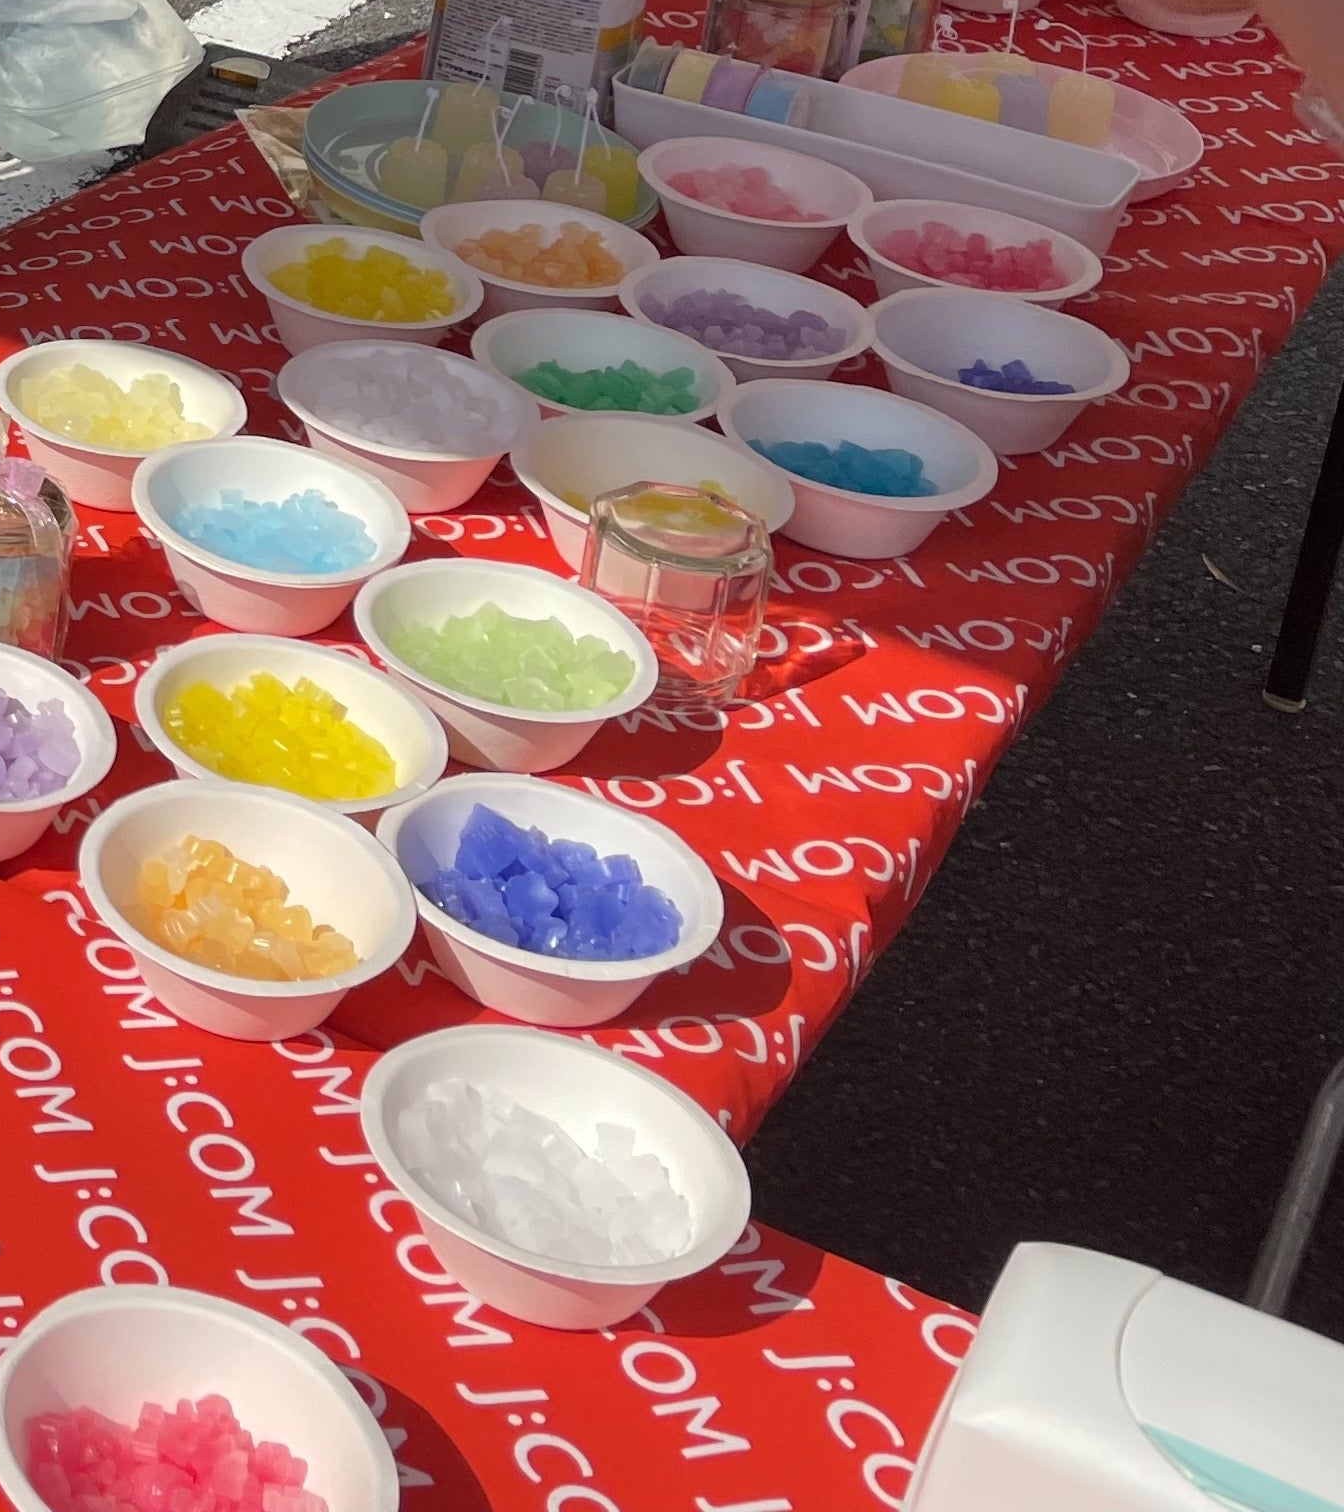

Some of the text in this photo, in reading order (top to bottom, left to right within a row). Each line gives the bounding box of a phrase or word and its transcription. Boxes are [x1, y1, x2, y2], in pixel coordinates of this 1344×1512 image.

[1162, 90, 1280, 114] J:CO
[101, 156, 245, 202] J:COM
[37, 198, 189, 241] J:COM
[1181, 237, 1326, 279] J:COM
[86, 274, 249, 300] J:COM
[1115, 327, 1262, 372] J:COM
[1041, 434, 1192, 468] J:COM
[992, 492, 1157, 534] J:COM
[946, 552, 1114, 599] J:COM
[897, 616, 1072, 664] J:COM
[616, 688, 821, 734] J:COM
[844, 684, 1029, 732] J:COM
[788, 760, 977, 818] J:COM
[721, 837, 921, 901] J:COM
[666, 922, 868, 989] J:COM
[581, 1014, 805, 1083] J:COM
[122, 1054, 294, 1238] J:COM
[33, 1162, 170, 1287] J:CO
[762, 1349, 918, 1511] J:CO
